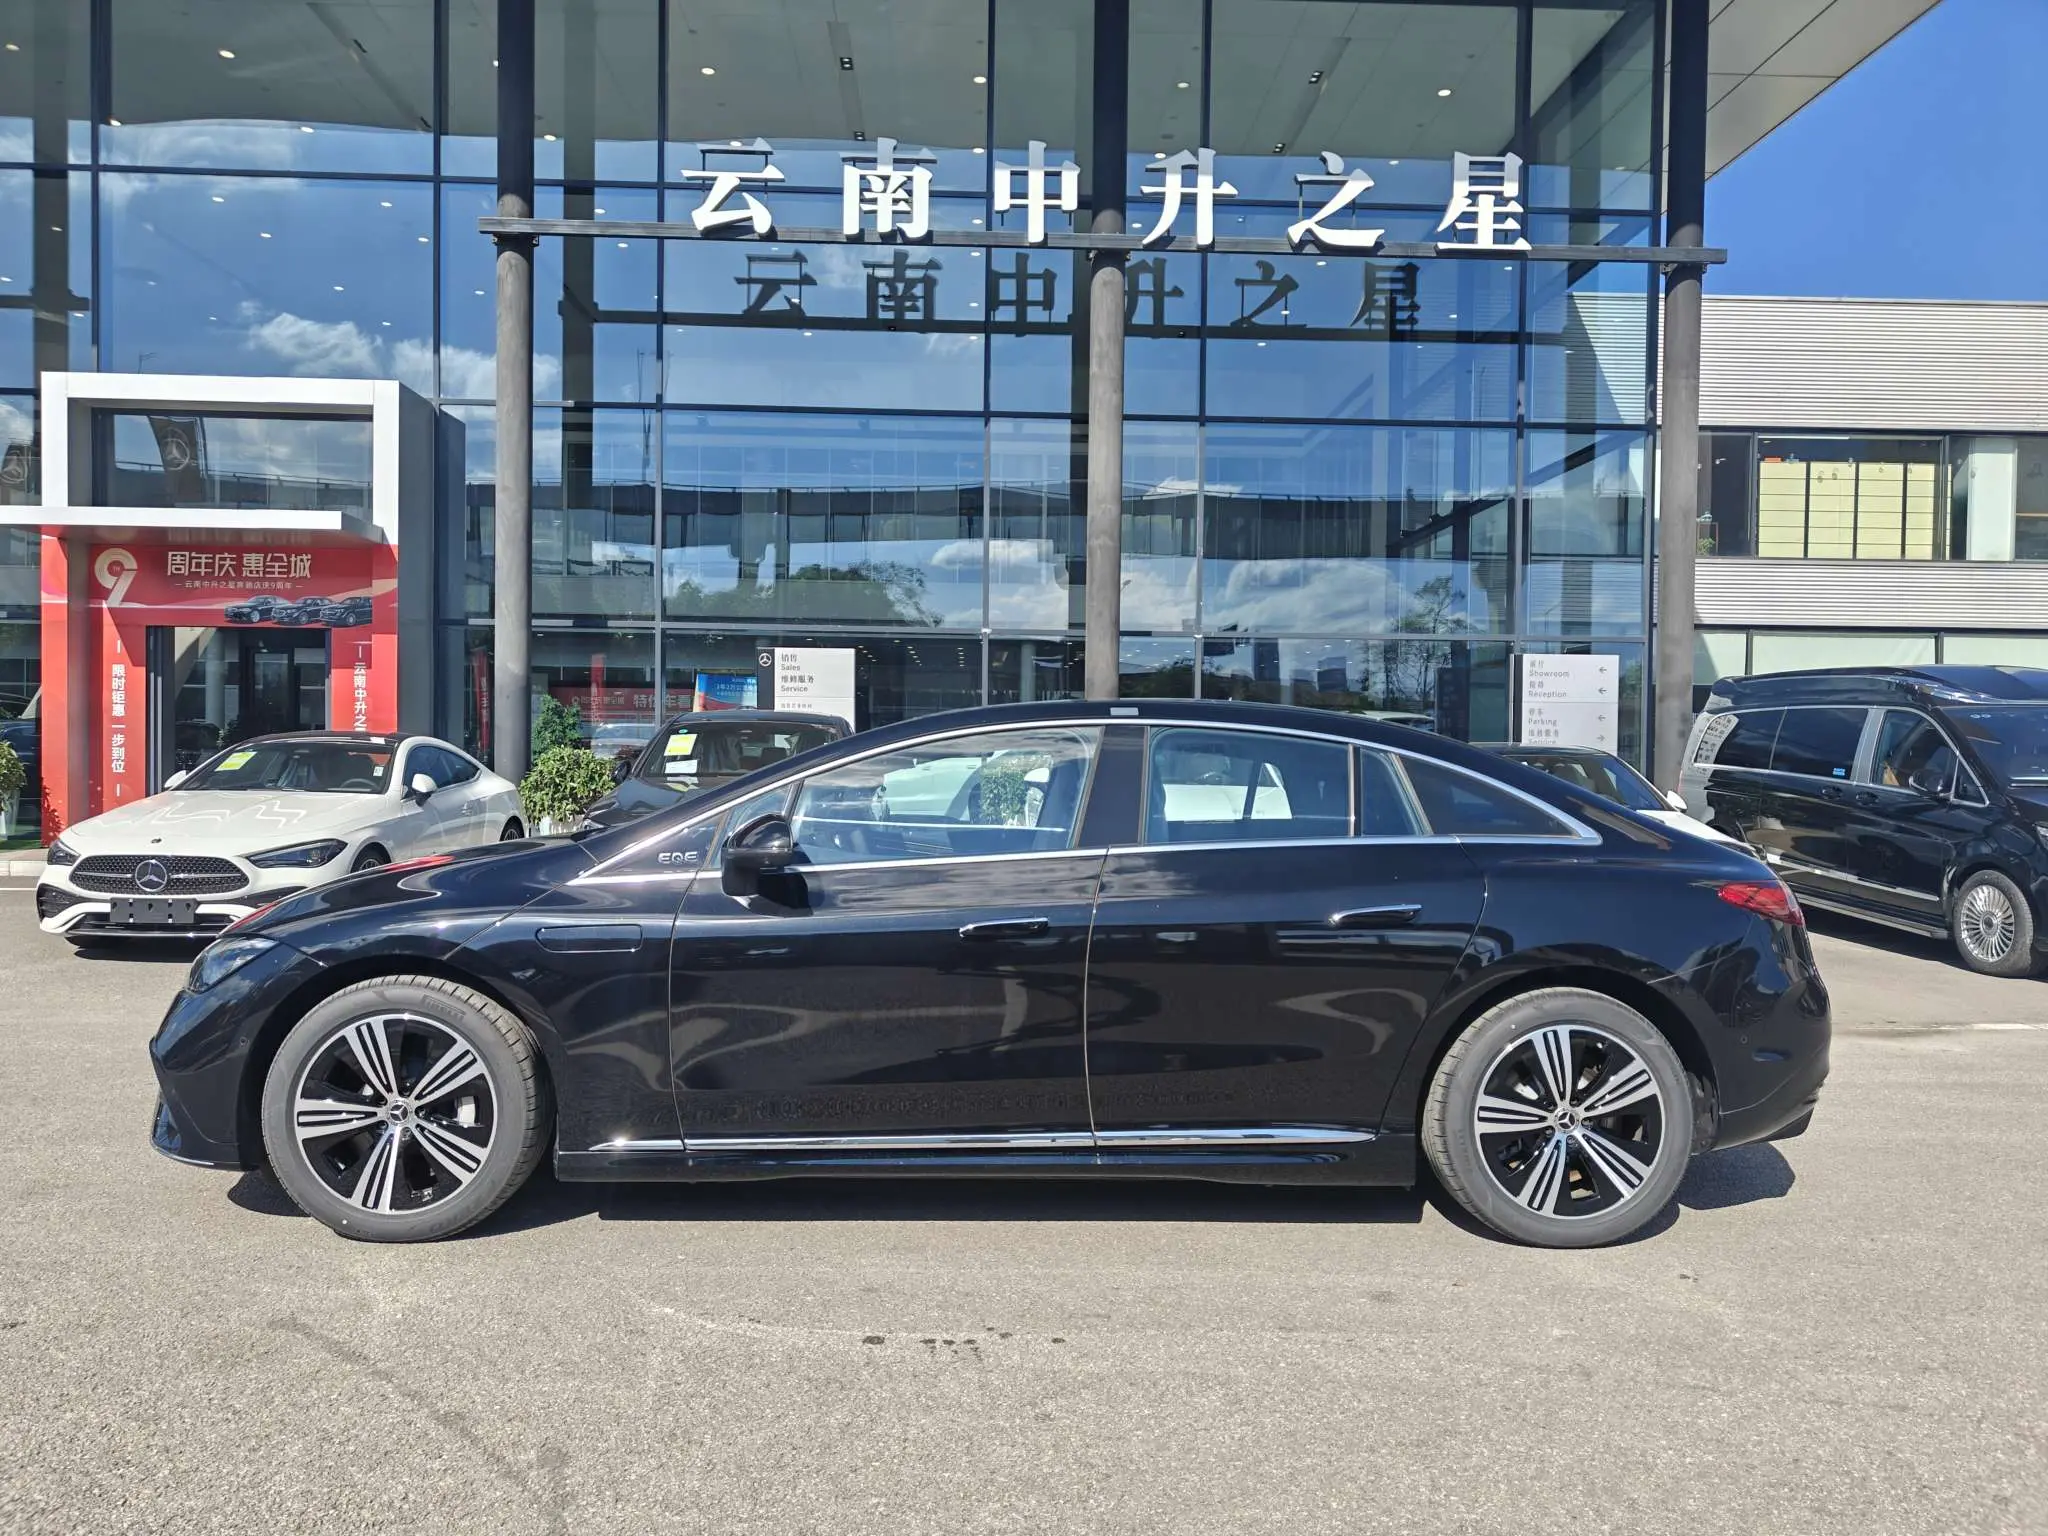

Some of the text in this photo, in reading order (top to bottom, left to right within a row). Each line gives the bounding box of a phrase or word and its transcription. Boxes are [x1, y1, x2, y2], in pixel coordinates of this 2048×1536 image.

[681, 137, 1533, 252] 云南中升之星
[167, 551, 312, 579] 周年庆 惠全城
[353, 662, 368, 731] 云南中升之
[1528, 690, 1567, 698] Reception
[1528, 718, 1557, 726] Parking
[658, 851, 698, 864] EQE
